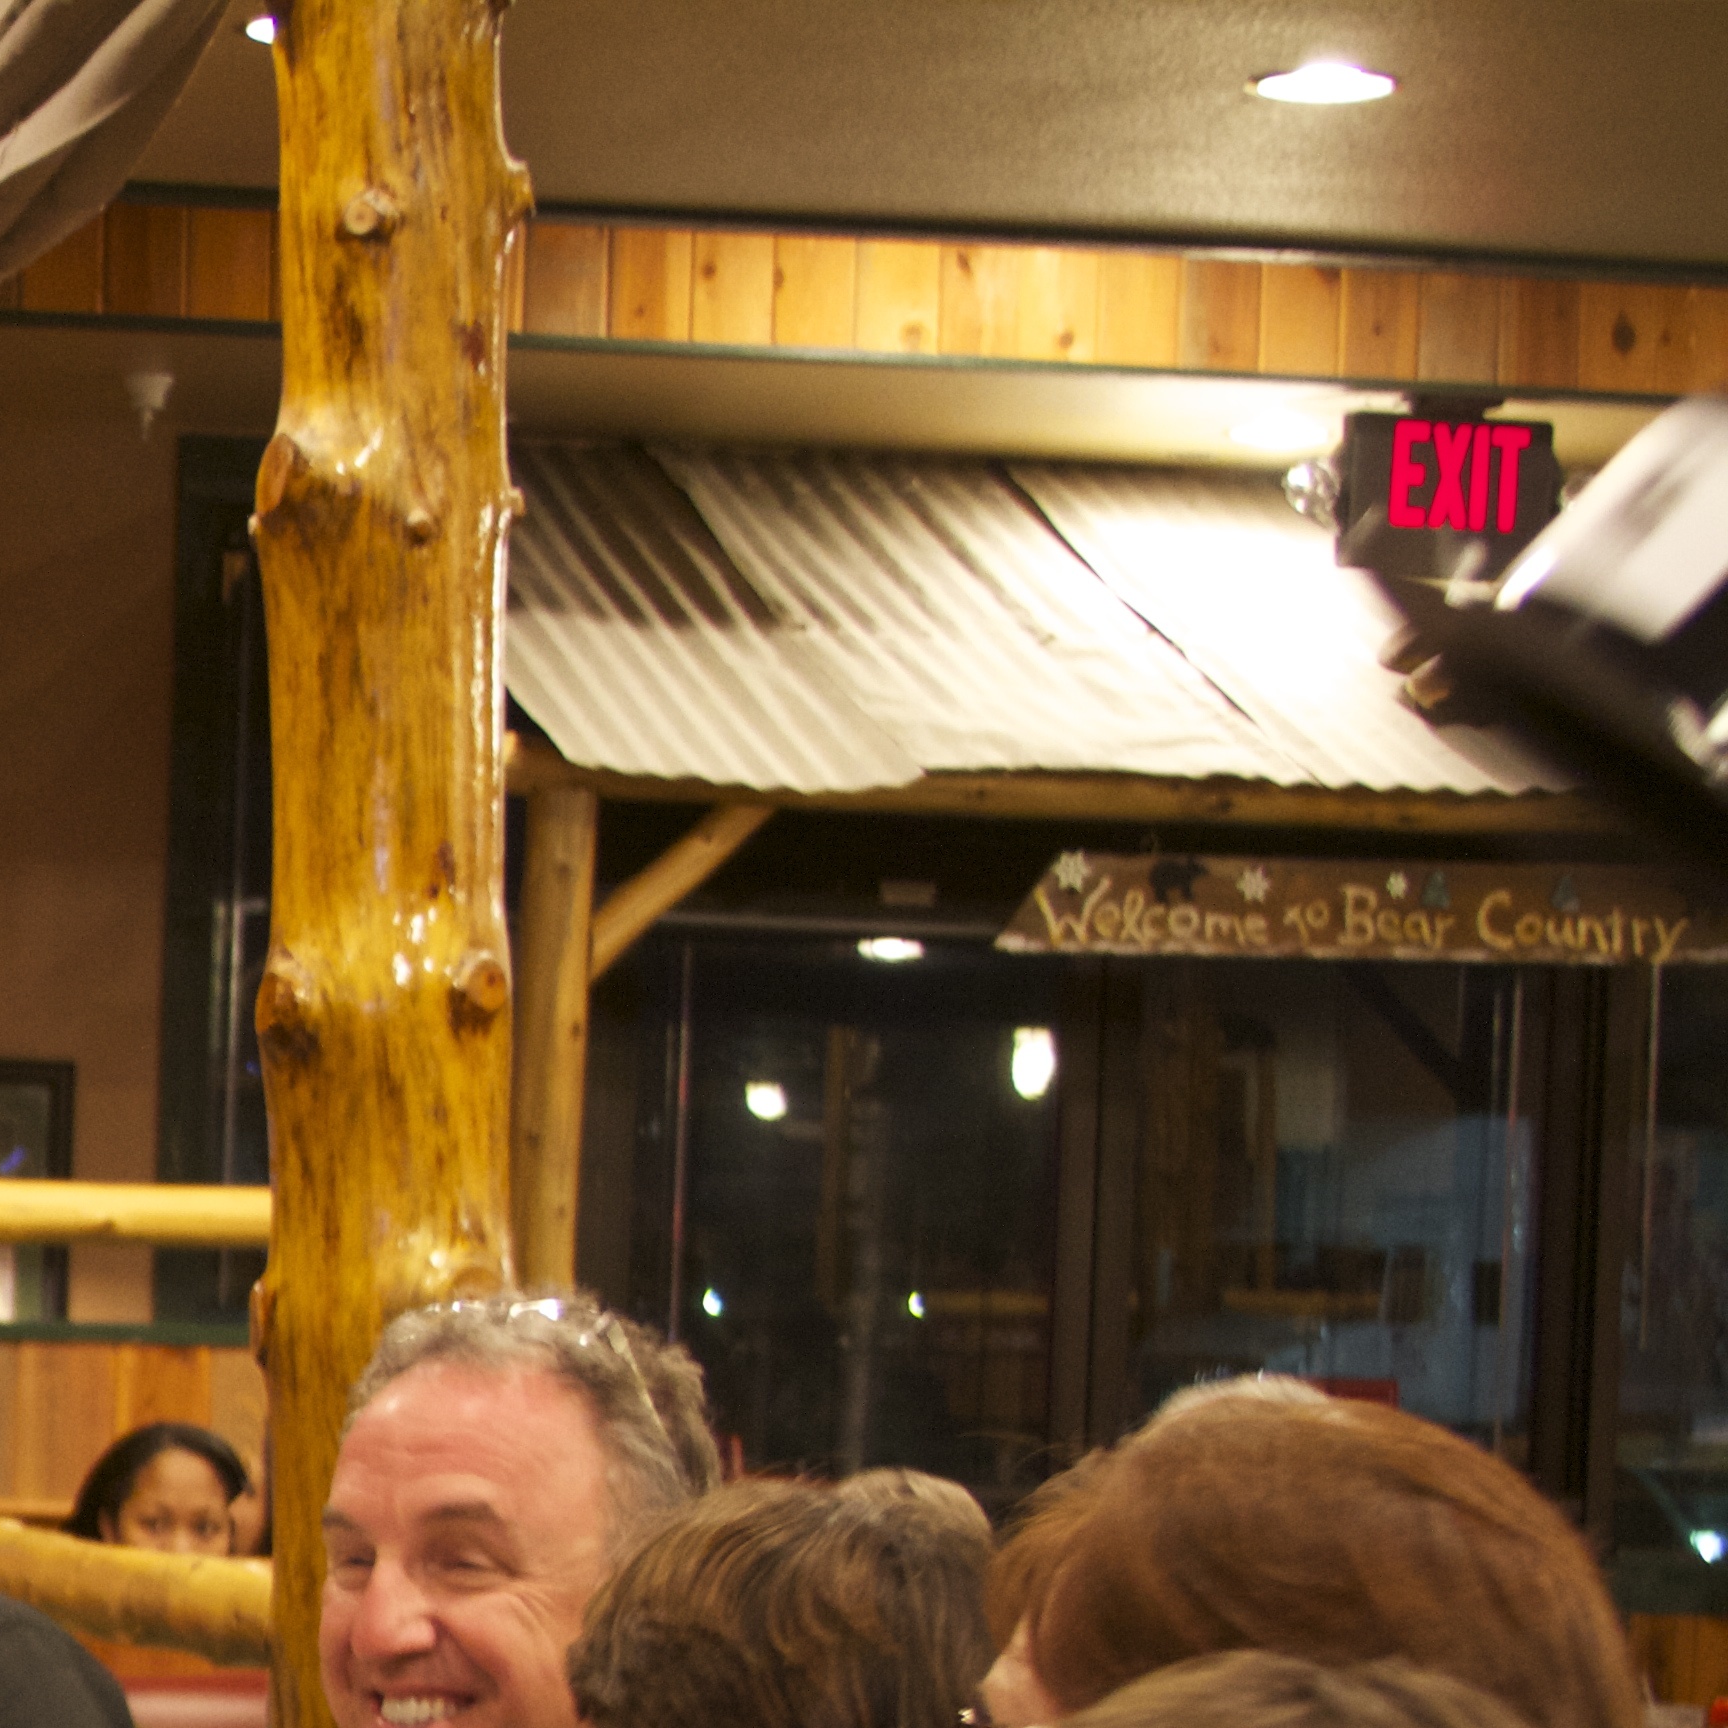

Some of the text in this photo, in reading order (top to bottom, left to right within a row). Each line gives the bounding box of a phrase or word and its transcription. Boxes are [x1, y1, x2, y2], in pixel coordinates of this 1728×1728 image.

[1387, 418, 1533, 535] EXIT
[1034, 876, 1269, 947] Welcome
[1338, 882, 1456, 950] Bear
[1476, 887, 1690, 964] Country
